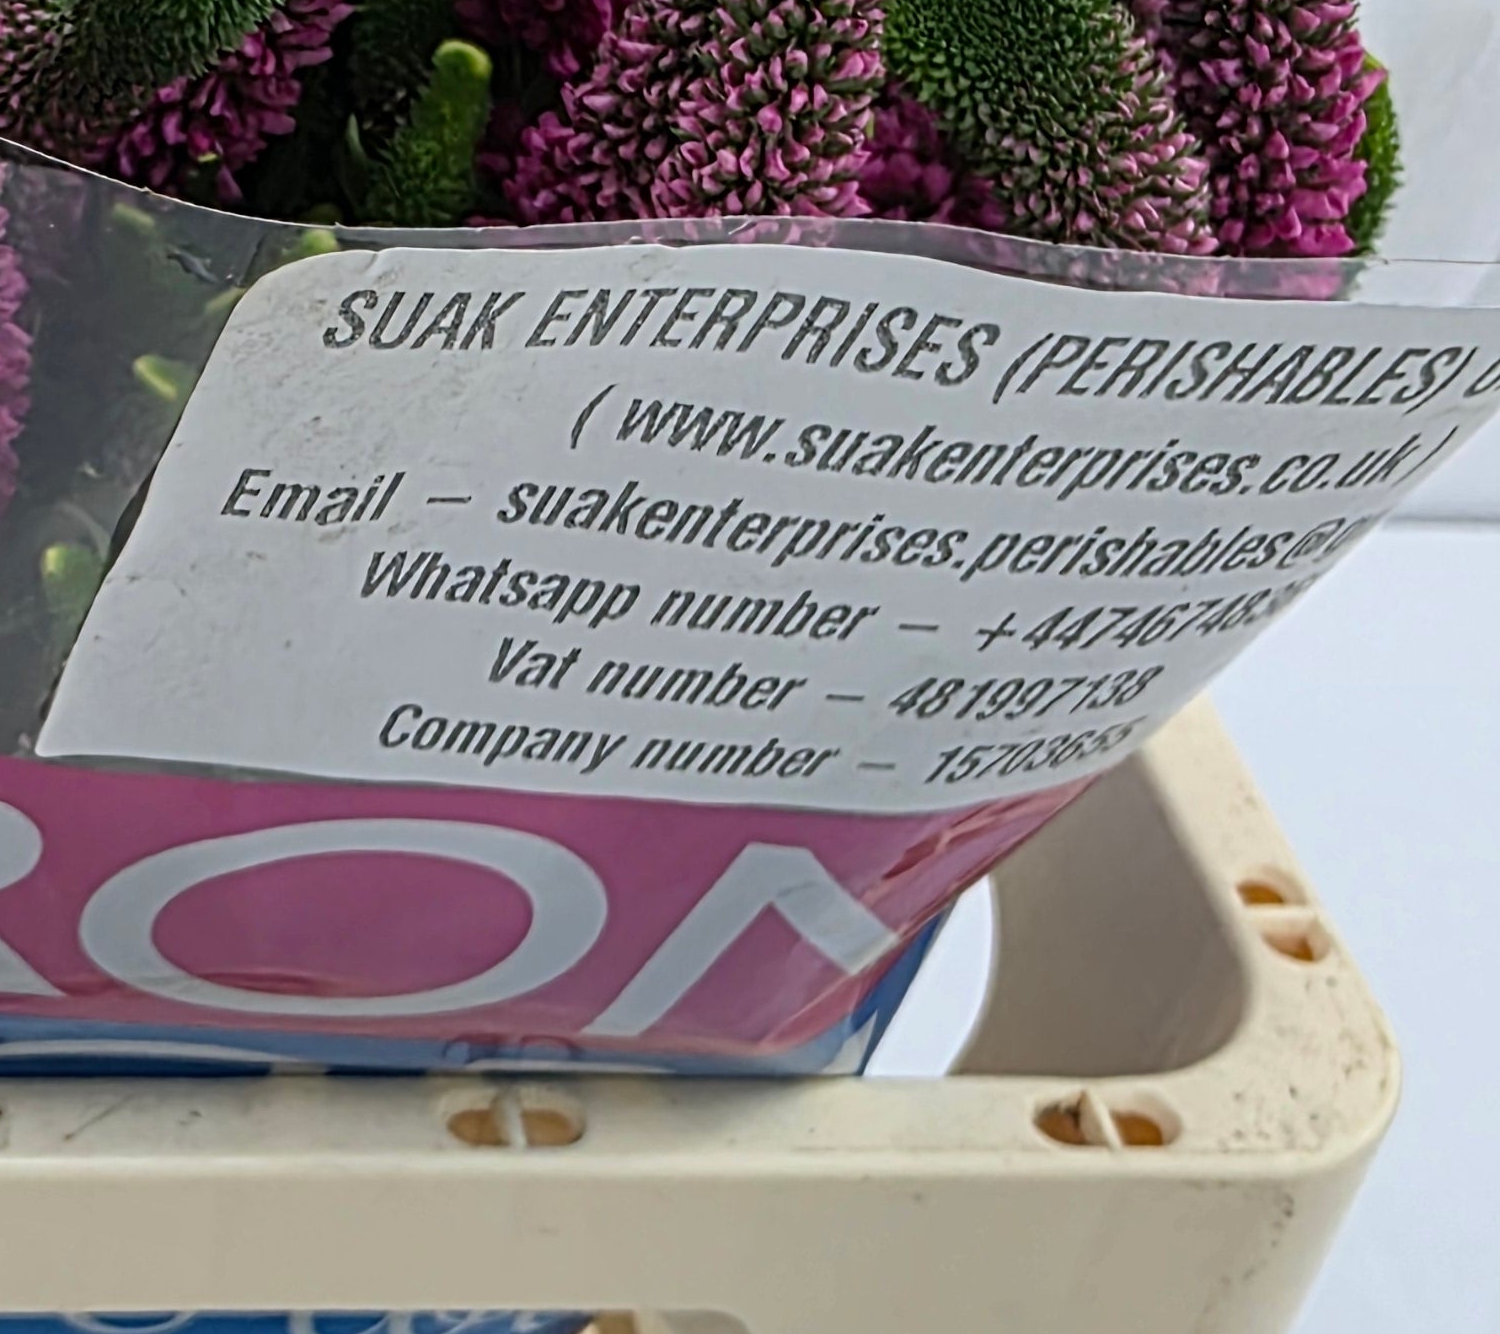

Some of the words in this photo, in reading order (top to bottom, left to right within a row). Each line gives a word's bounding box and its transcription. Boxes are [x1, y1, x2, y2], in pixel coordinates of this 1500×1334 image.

[322, 288, 527, 352] SUAK
[523, 287, 1001, 387] ENTERPRISES
[991, 333, 1478, 417] (PERISHABLES)
[615, 397, 1420, 501] www.suakenterprises.co.uk
[220, 468, 407, 527] Email
[359, 549, 642, 628] Whatsapp
[649, 588, 881, 641] number
[487, 636, 583, 691] Vat
[585, 660, 809, 713] number
[887, 664, 1166, 720] 481997138
[377, 702, 629, 775] Company
[629, 731, 841, 780] number
